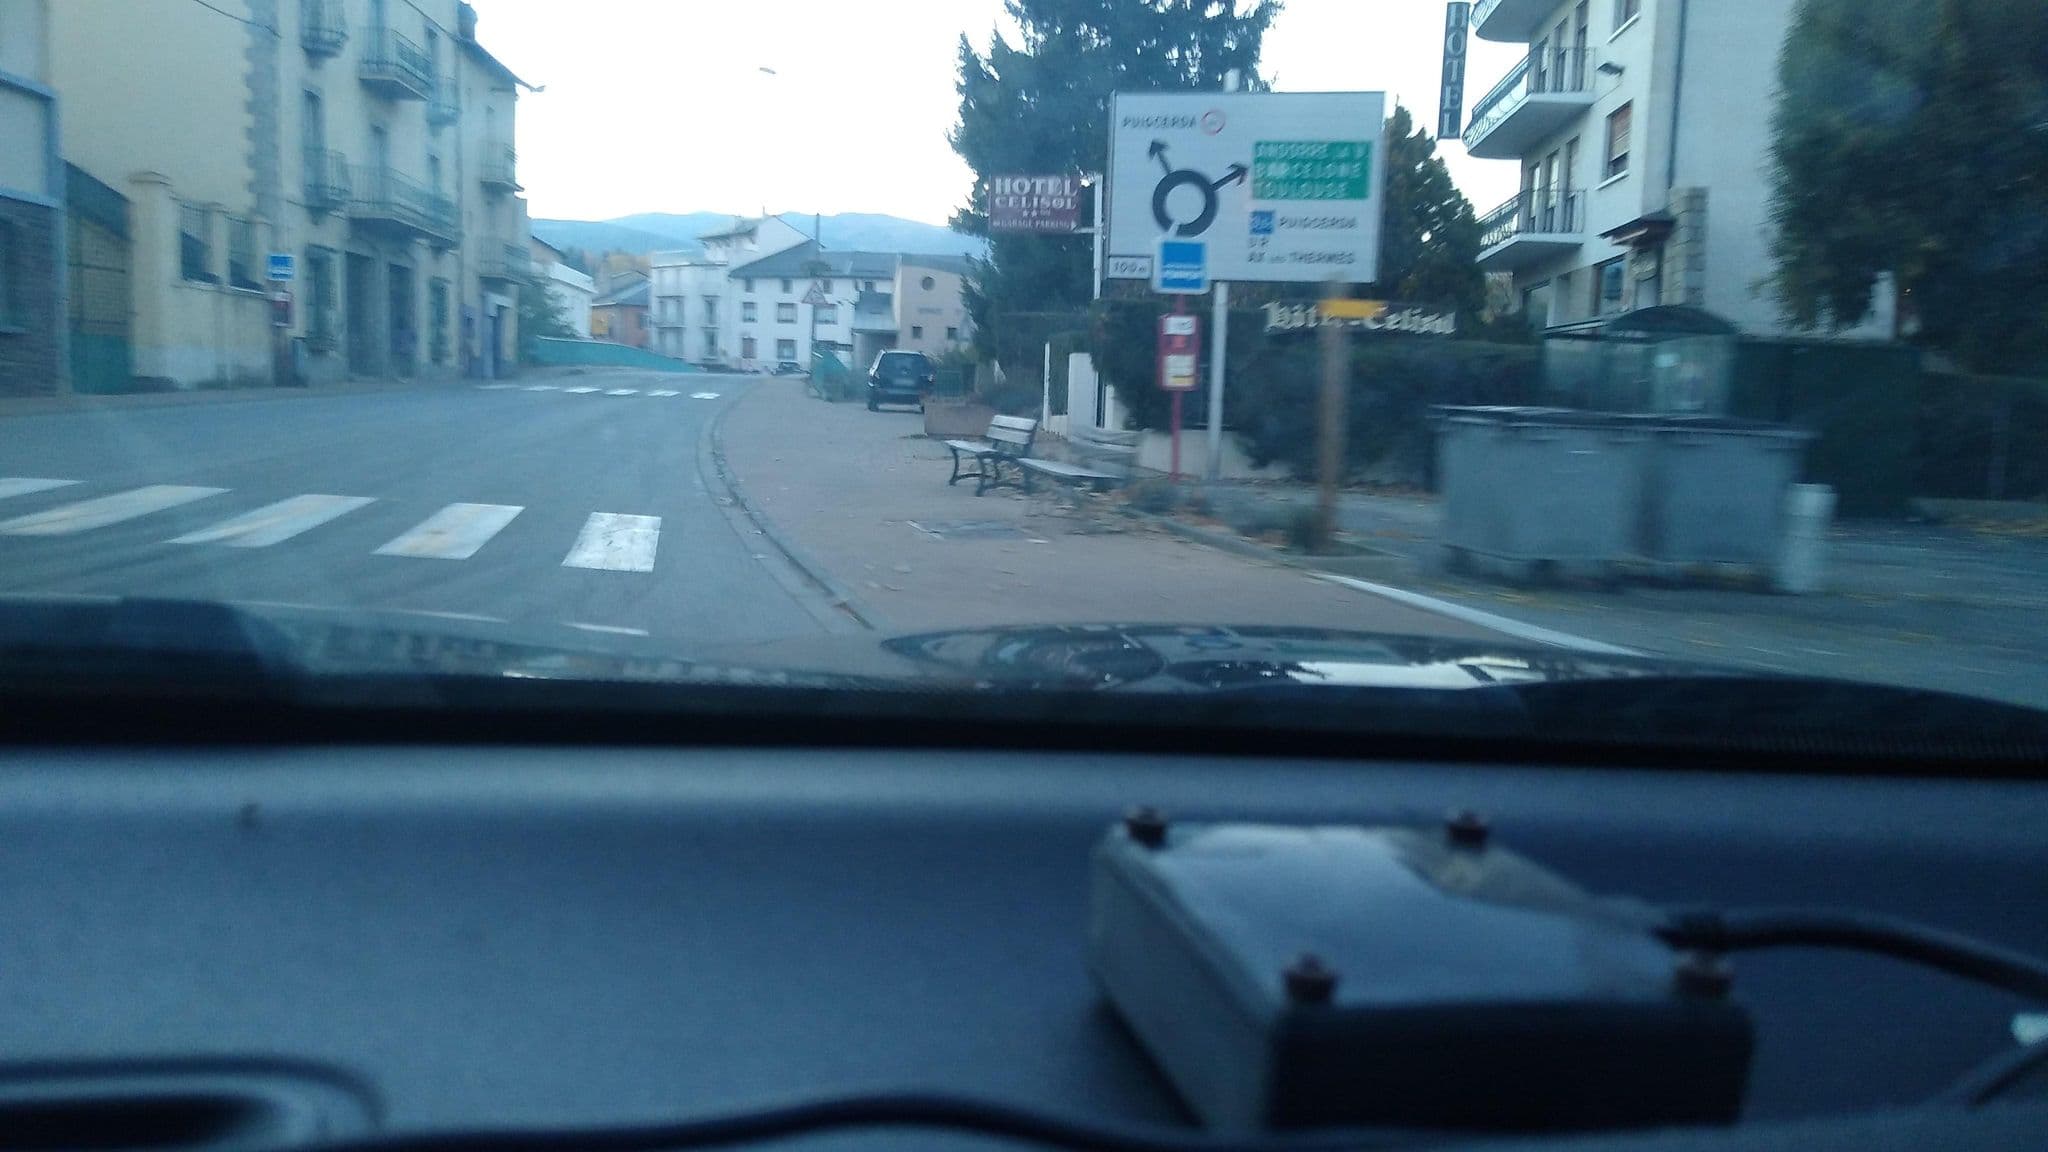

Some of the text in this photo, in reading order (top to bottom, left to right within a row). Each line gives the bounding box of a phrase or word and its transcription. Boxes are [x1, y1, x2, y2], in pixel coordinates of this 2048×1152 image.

[1442, 4, 1466, 137] HOTEL
[995, 177, 1078, 198] HOTEL
[1255, 182, 1347, 200] TOULOUSE
[995, 195, 1077, 210] CELISOL
